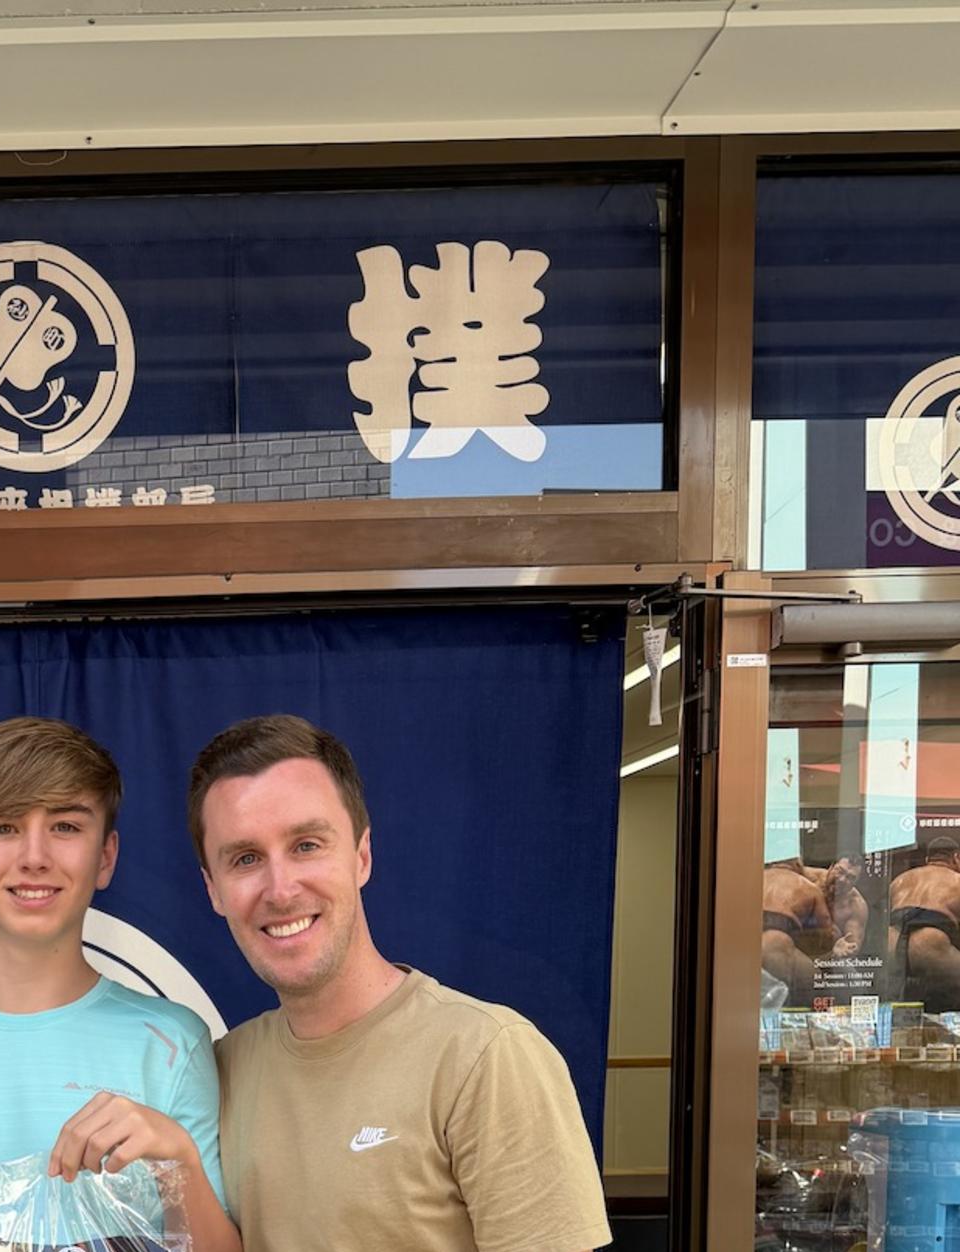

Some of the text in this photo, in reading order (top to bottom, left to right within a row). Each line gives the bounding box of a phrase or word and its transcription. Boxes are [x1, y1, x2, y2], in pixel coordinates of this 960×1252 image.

[347, 240, 551, 464] 撲
[814, 956, 883, 969] Session Schedule
